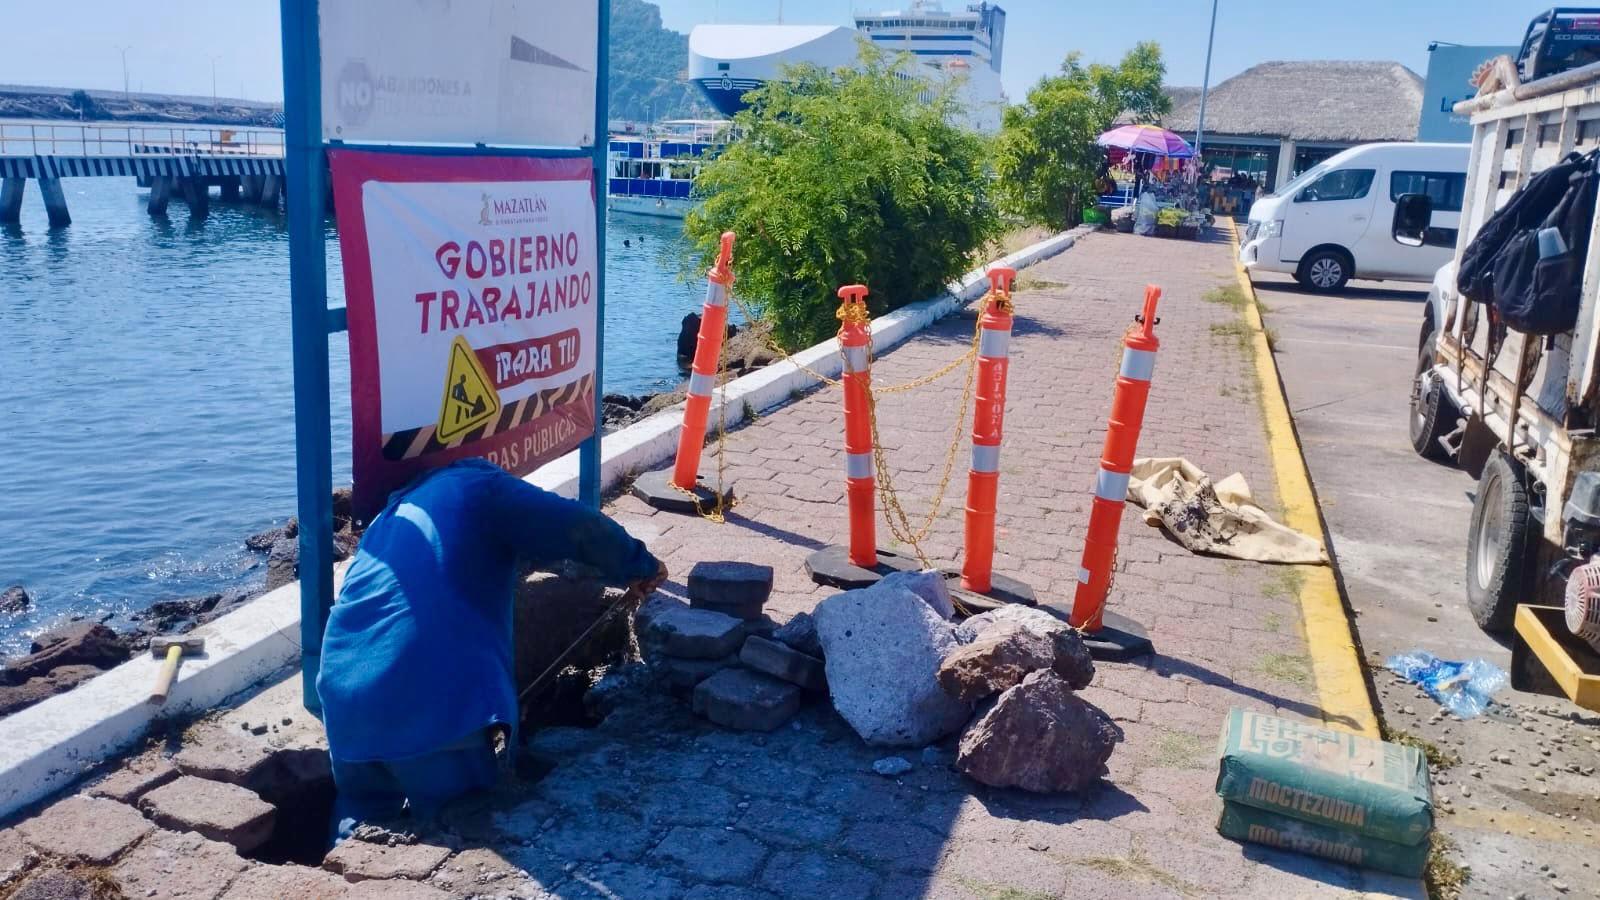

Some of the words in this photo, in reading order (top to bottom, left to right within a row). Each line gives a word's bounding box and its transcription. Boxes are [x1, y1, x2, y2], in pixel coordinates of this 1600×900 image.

[340, 80, 371, 106] NO
[493, 193, 547, 215] MAZATLÁN
[435, 232, 578, 280] GOBIERNO
[415, 271, 591, 334] TRABAJANDO
[495, 343, 552, 384] ¡PARA
[558, 335, 575, 367] TI!
[523, 412, 577, 462] PÚBLICAS
[1249, 776, 1364, 826] MOCTEZUMA
